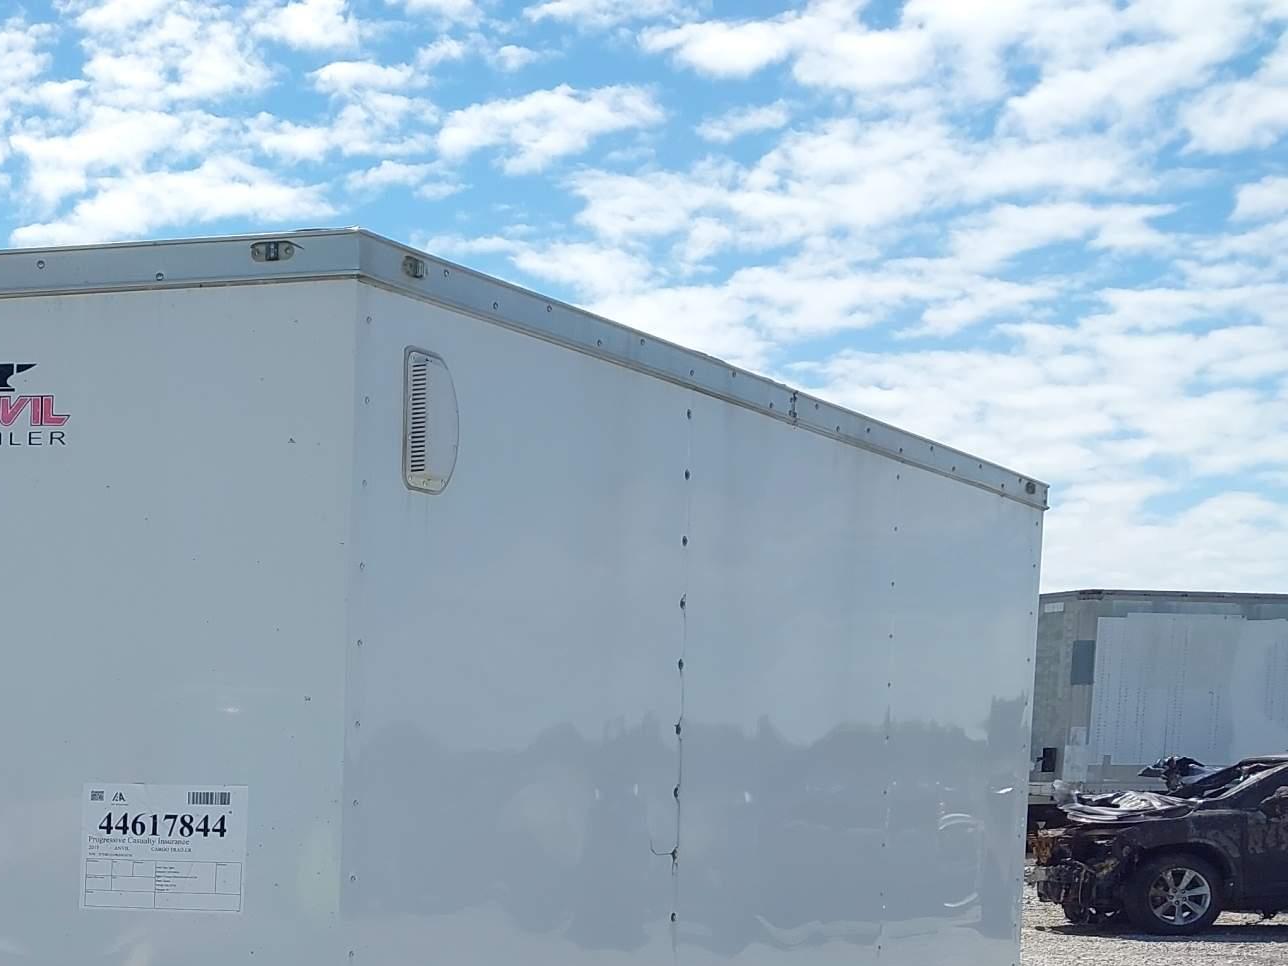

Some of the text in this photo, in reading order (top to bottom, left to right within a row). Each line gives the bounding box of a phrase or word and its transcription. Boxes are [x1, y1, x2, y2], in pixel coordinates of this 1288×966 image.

[99, 812, 227, 837] 44617844
[88, 836, 191, 846] Progressive Casualty Insurance
